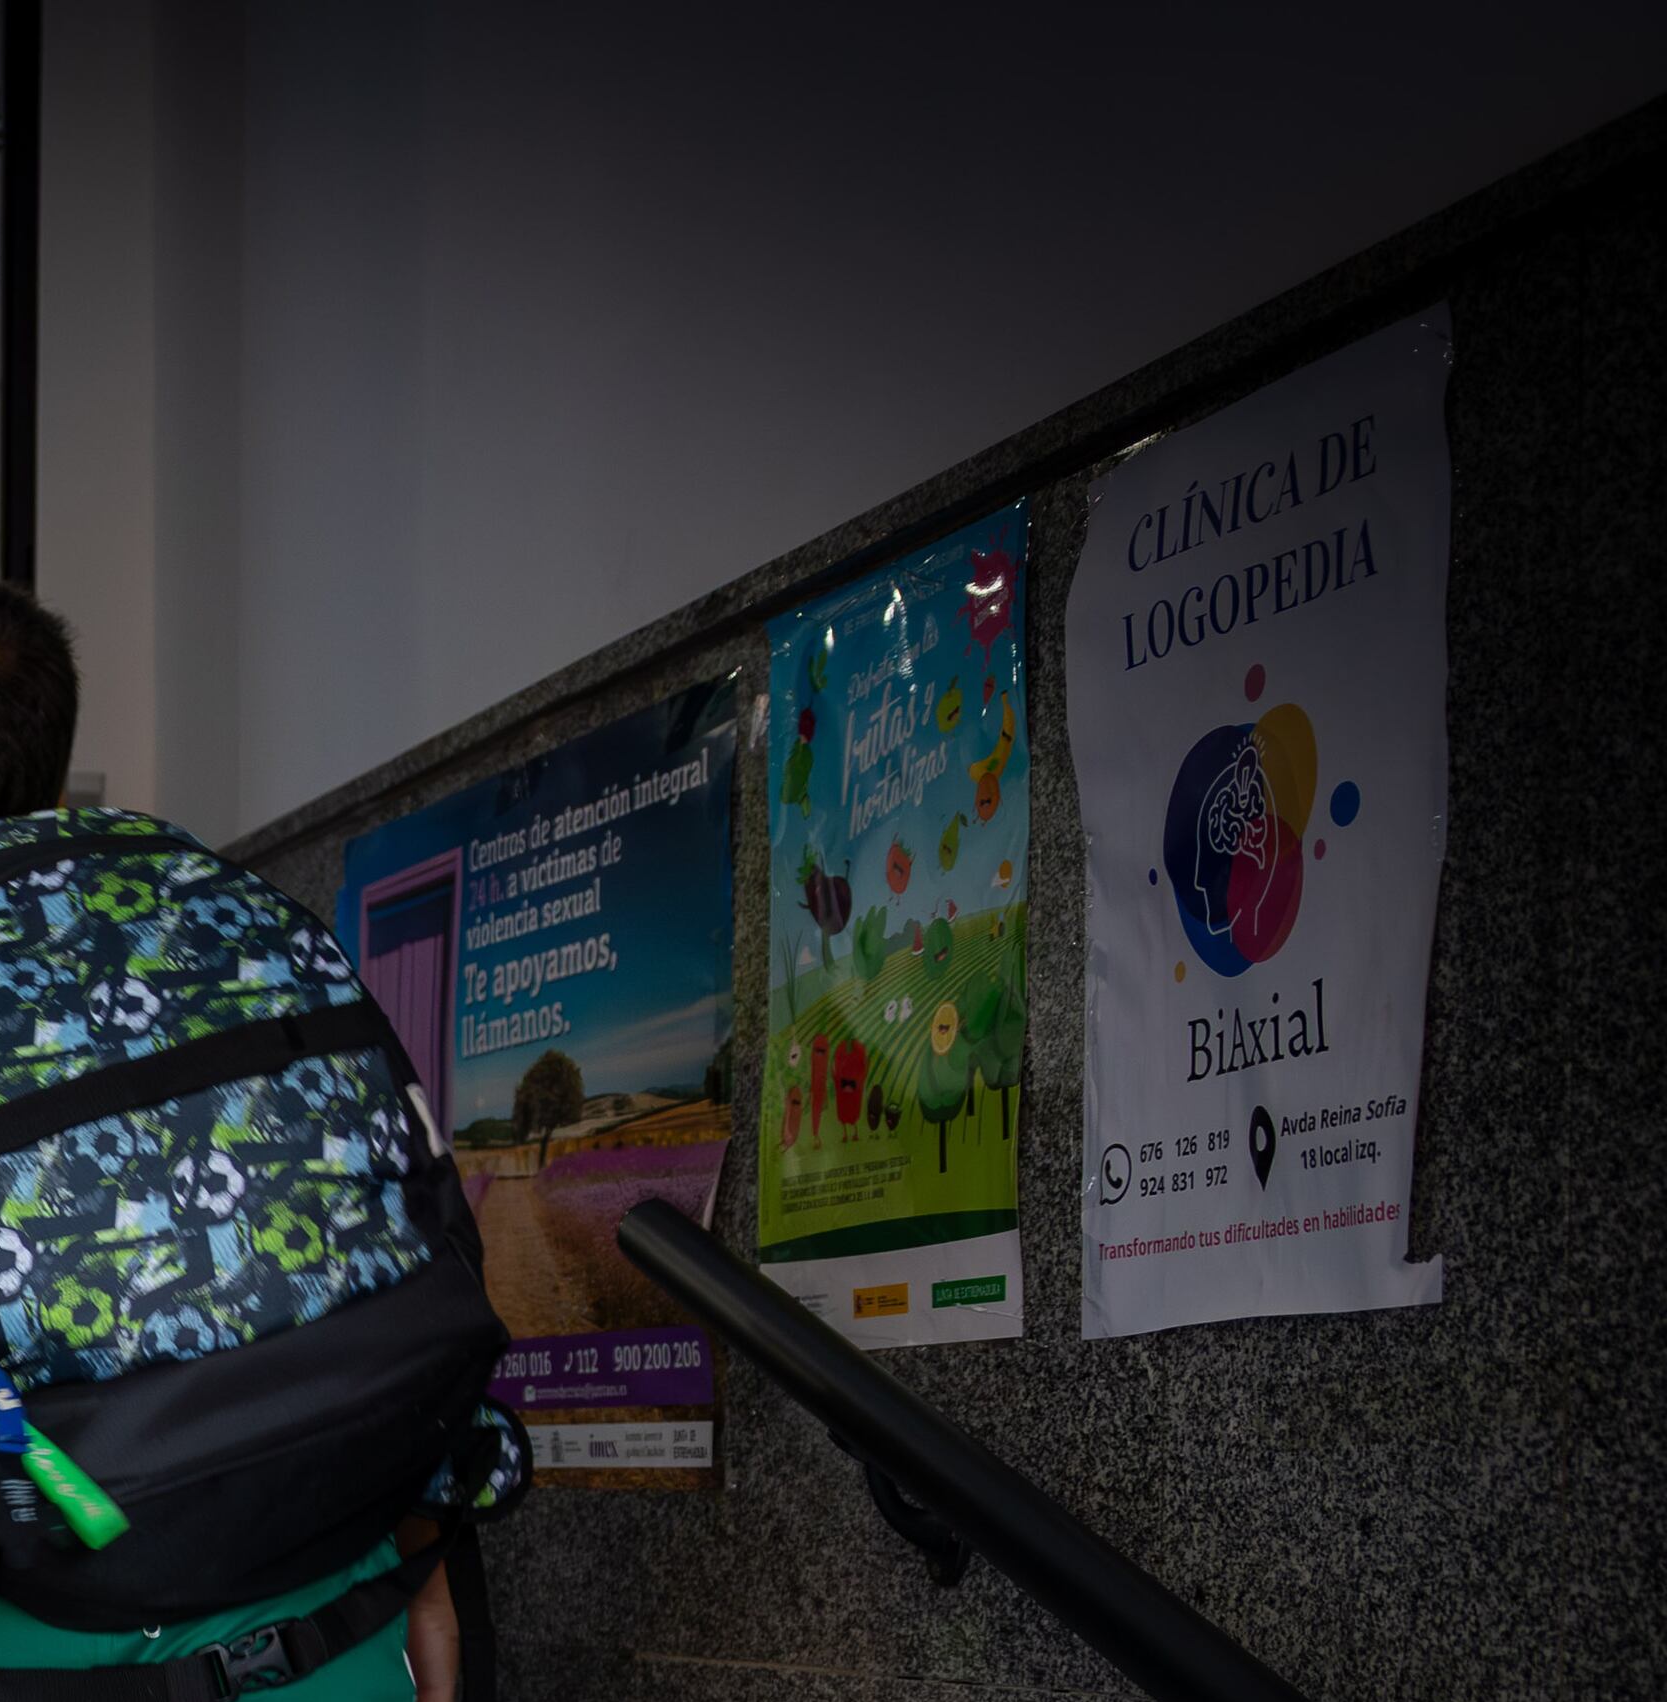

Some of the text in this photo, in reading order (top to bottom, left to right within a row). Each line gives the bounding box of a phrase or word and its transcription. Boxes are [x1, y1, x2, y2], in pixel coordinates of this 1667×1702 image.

[1127, 413, 1378, 572] CLÍNICA DE
[1122, 517, 1379, 671] LOGOPEDIA
[468, 747, 709, 872] Centros de atención integral
[848, 740, 947, 840] hortalizas
[468, 879, 486, 912] 24
[507, 875, 517, 899] a
[519, 847, 598, 893] víctimas
[601, 830, 622, 867] de
[466, 877, 601, 951] violencia sexual
[464, 933, 619, 1005] Te apoyamos,
[461, 1001, 571, 1058] llámanos.
[1187, 977, 1329, 1083] BiAxial
[1140, 1129, 1230, 1163] 676 126 819
[1280, 1112, 1317, 1137] Avda
[1320, 1105, 1361, 1130] Reina
[1140, 1165, 1228, 1197] 924 831 972
[1300, 1138, 1381, 1170] 18 local izq.
[1098, 1201, 1401, 1261] Transformando tus dificultades en habilidades
[505, 1353, 527, 1378] 260
[529, 1350, 552, 1377] 016
[576, 1347, 599, 1374] 112
[613, 1340, 701, 1372] 900 200 206
